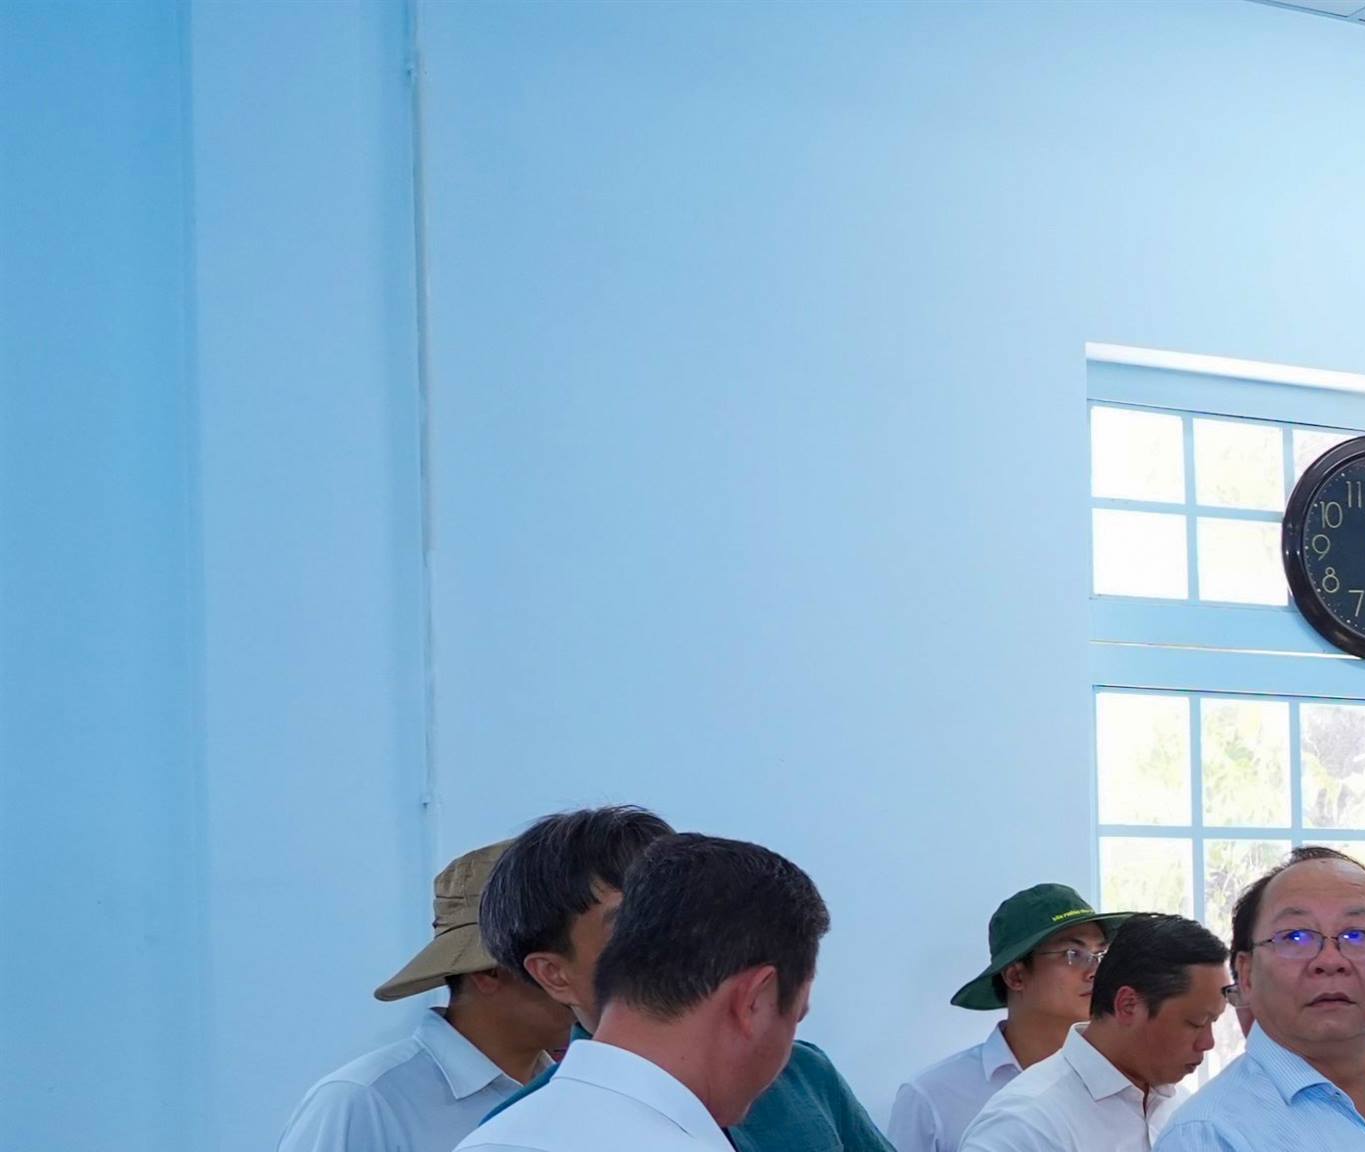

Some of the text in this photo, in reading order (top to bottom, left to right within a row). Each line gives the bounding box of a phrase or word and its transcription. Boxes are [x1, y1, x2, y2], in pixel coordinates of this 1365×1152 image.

[1346, 480, 1363, 509] 11
[1319, 500, 1344, 529] 10
[1311, 534, 1331, 561] 9
[1321, 566, 1341, 594] 8
[1348, 589, 1365, 617] 7
